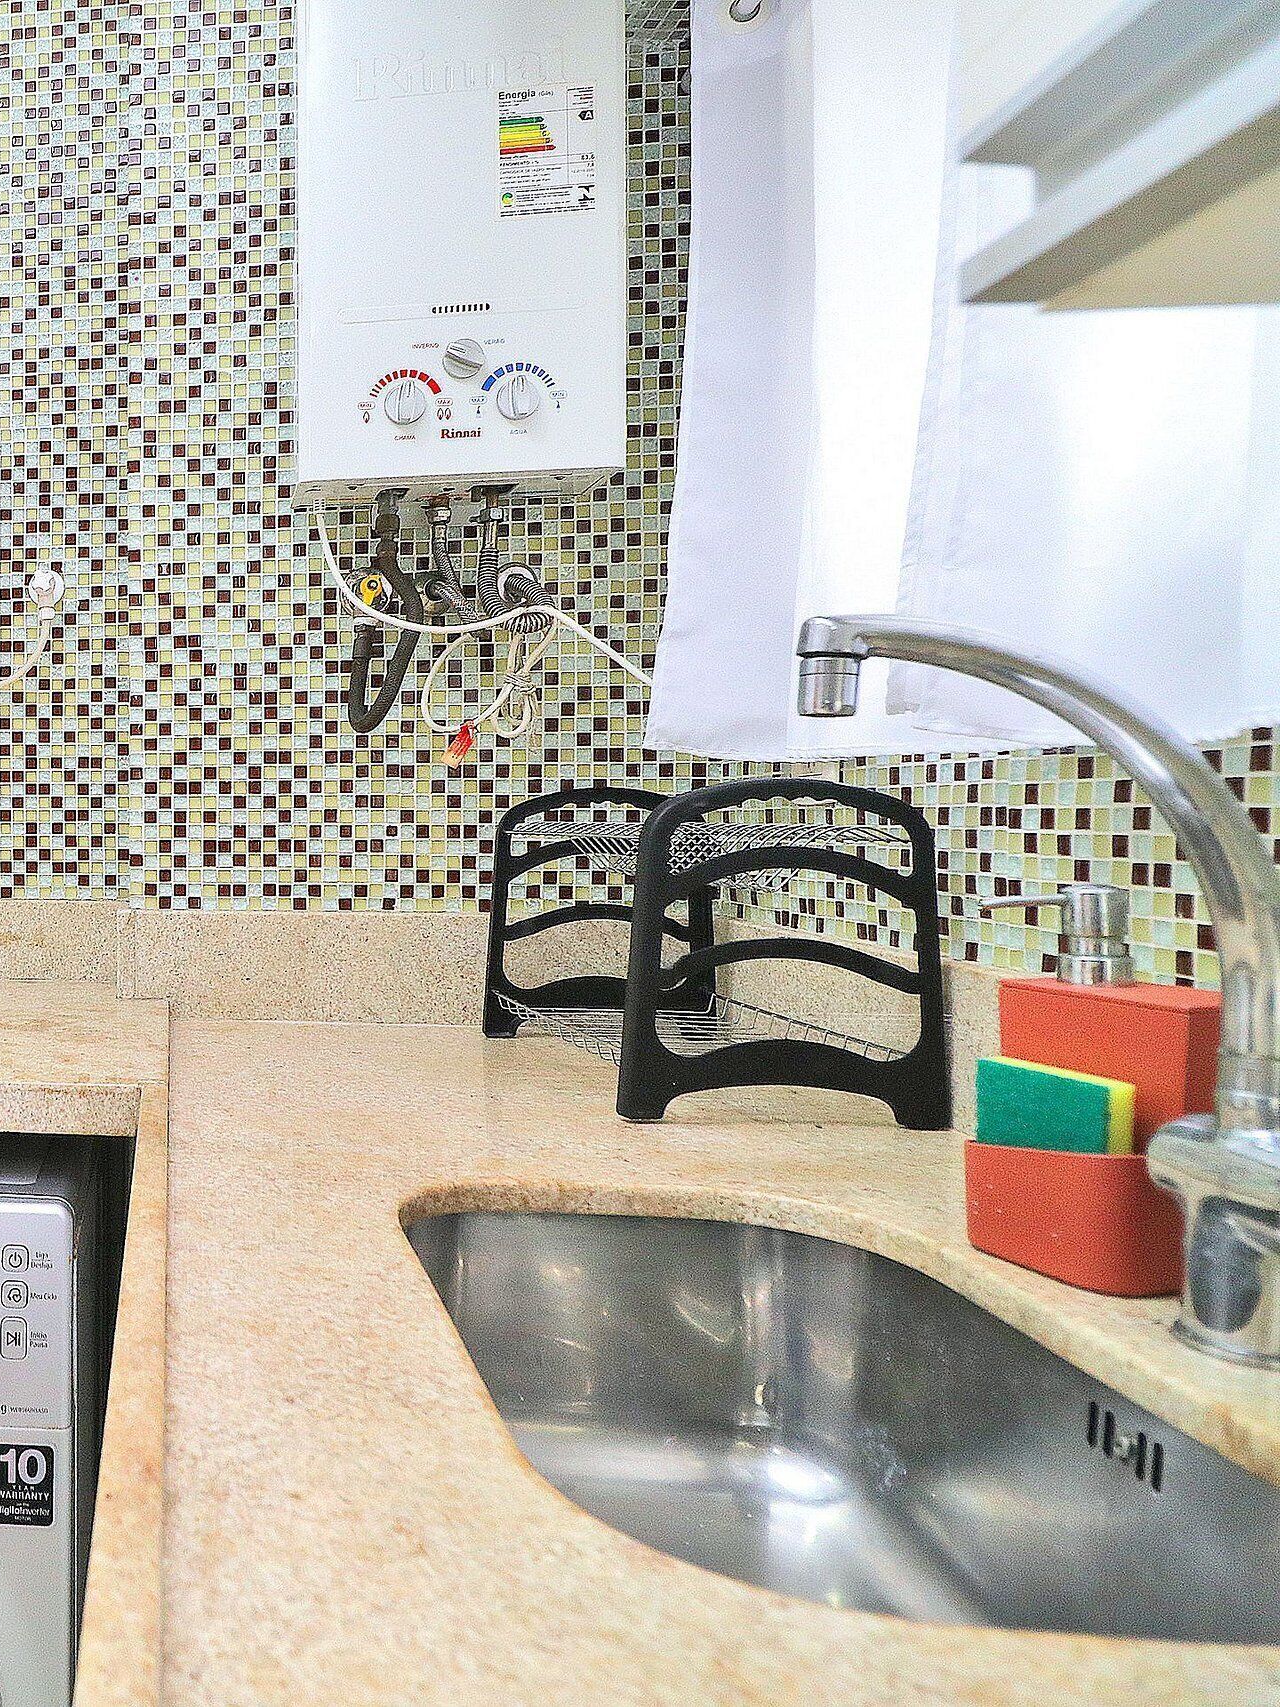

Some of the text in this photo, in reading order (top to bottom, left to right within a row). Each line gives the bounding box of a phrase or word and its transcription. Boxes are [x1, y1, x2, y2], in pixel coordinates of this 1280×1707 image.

[498, 89, 536, 100] Energia
[584, 111, 593, 120] A
[440, 427, 482, 439] Rinnai
[0, 1448, 47, 1485] 10
